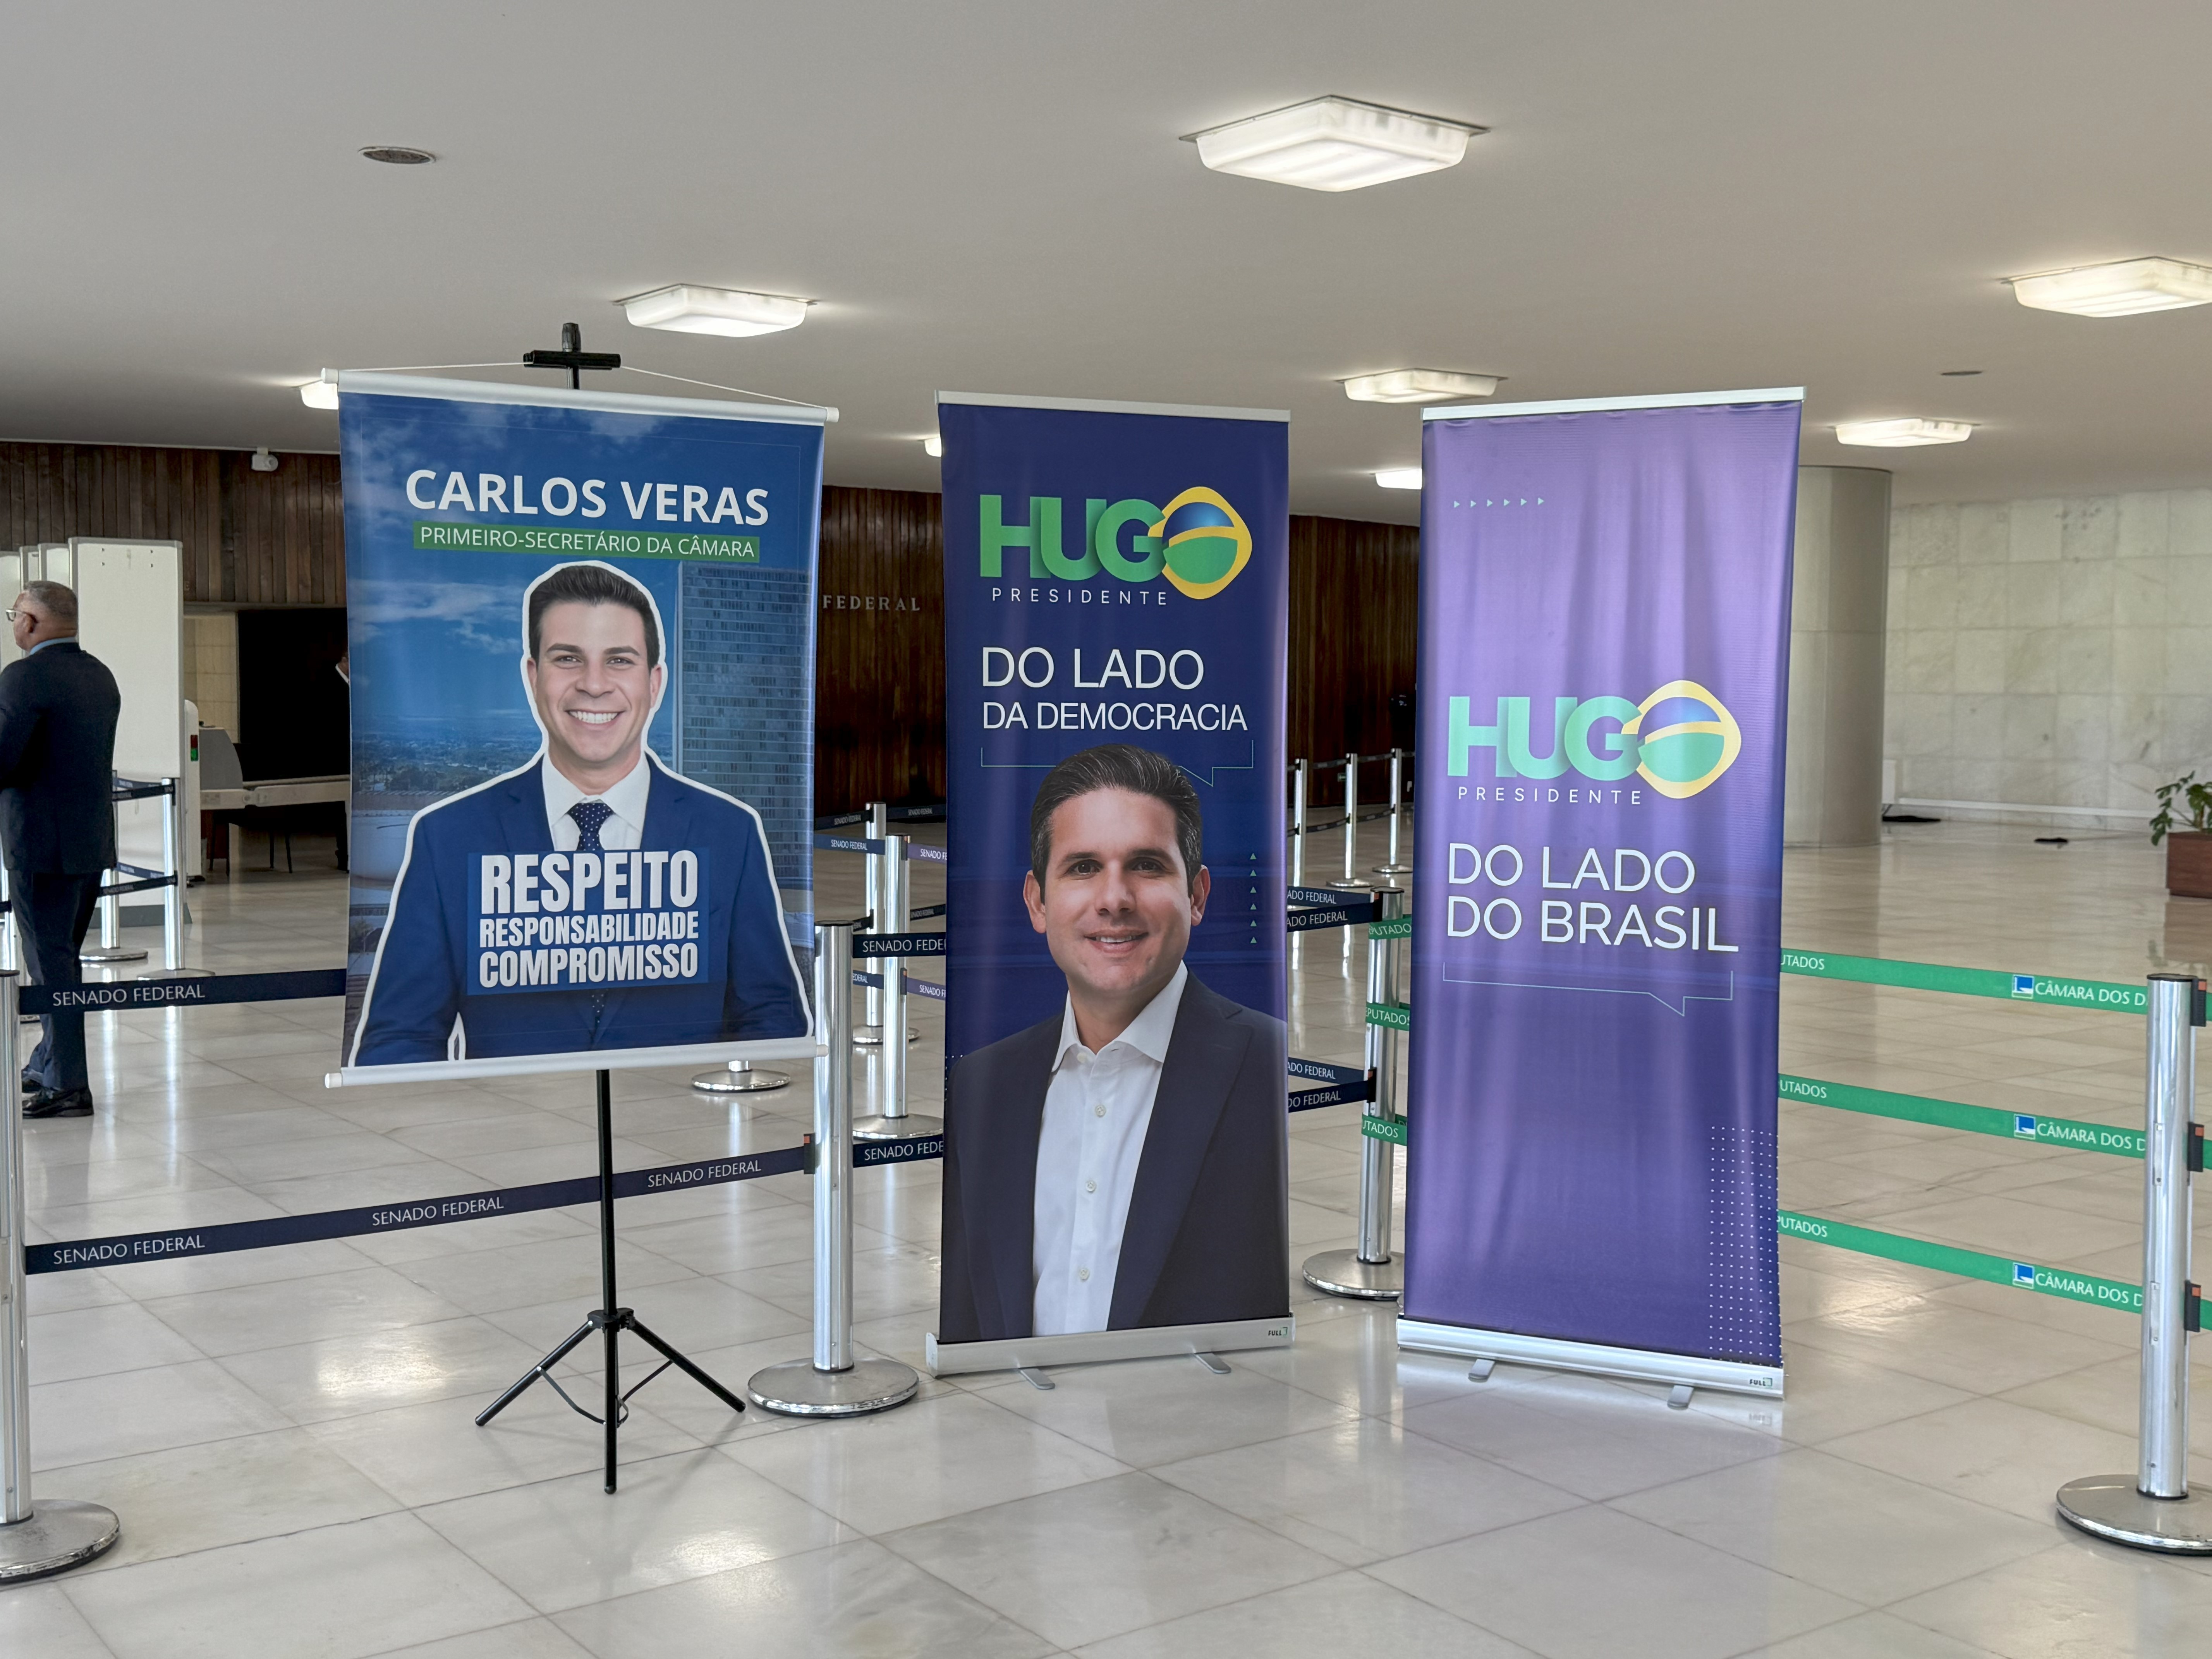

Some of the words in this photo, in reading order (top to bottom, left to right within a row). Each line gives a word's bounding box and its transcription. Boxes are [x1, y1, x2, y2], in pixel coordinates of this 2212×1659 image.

[406, 469, 606, 518] CARLOS
[620, 481, 769, 526] VERAS
[420, 526, 640, 554] PRIMEIRO-SECRETÁRIO
[647, 536, 673, 554] DA
[677, 535, 755, 557] CÂMARA
[980, 486, 1252, 599] HUGO
[823, 595, 920, 611] FEDERAL
[993, 588, 1167, 605] PRESIDENTE
[982, 647, 1054, 688] DO
[1074, 648, 1204, 690] LADO
[983, 702, 1029, 729] DA
[1037, 702, 1248, 731] DEMOCRACIA
[1448, 680, 1741, 799] HUGO
[1458, 787, 1641, 804] PRESIDENTE
[831, 840, 849, 848] SENADO
[850, 841, 868, 850] FEDERAL
[920, 848, 941, 859] SENADO
[481, 850, 698, 914] RESPEITO
[1449, 843, 1523, 886] DO
[1543, 847, 1695, 894] LADO
[1306, 891, 1336, 904] FEDERAL
[479, 911, 699, 948] RESPONSABILIDADE
[1310, 911, 1348, 924] FEDERAL
[1448, 896, 1522, 939] DO
[1542, 900, 1739, 952] BRASIL
[863, 939, 912, 953] SENADO
[917, 939, 946, 951] FEDE
[479, 943, 698, 988] COMPROMISSO
[53, 988, 127, 1006] SENADO
[133, 984, 205, 1002] FEDERAL
[920, 984, 940, 996] SENADO
[2035, 980, 2094, 1000] CÂMARA
[2099, 989, 2130, 1004] DOS
[1305, 1065, 1336, 1079] FEDERAL
[1304, 1091, 1341, 1106] FEDERAL
[2037, 1122, 2096, 1144] CÂMARA
[2100, 1132, 2131, 1149] DOS
[864, 1144, 913, 1161] SENADO
[647, 1168, 704, 1188] SENADO
[708, 1160, 762, 1180] FEDERAL
[372, 1205, 437, 1226] SENADO
[442, 1196, 504, 1217] FEDERAL
[53, 1243, 127, 1265] SENADO
[134, 1234, 205, 1255] FEDERAL
[2035, 1272, 2094, 1297] CÂMARA
[2098, 1285, 2129, 1304] DOS
